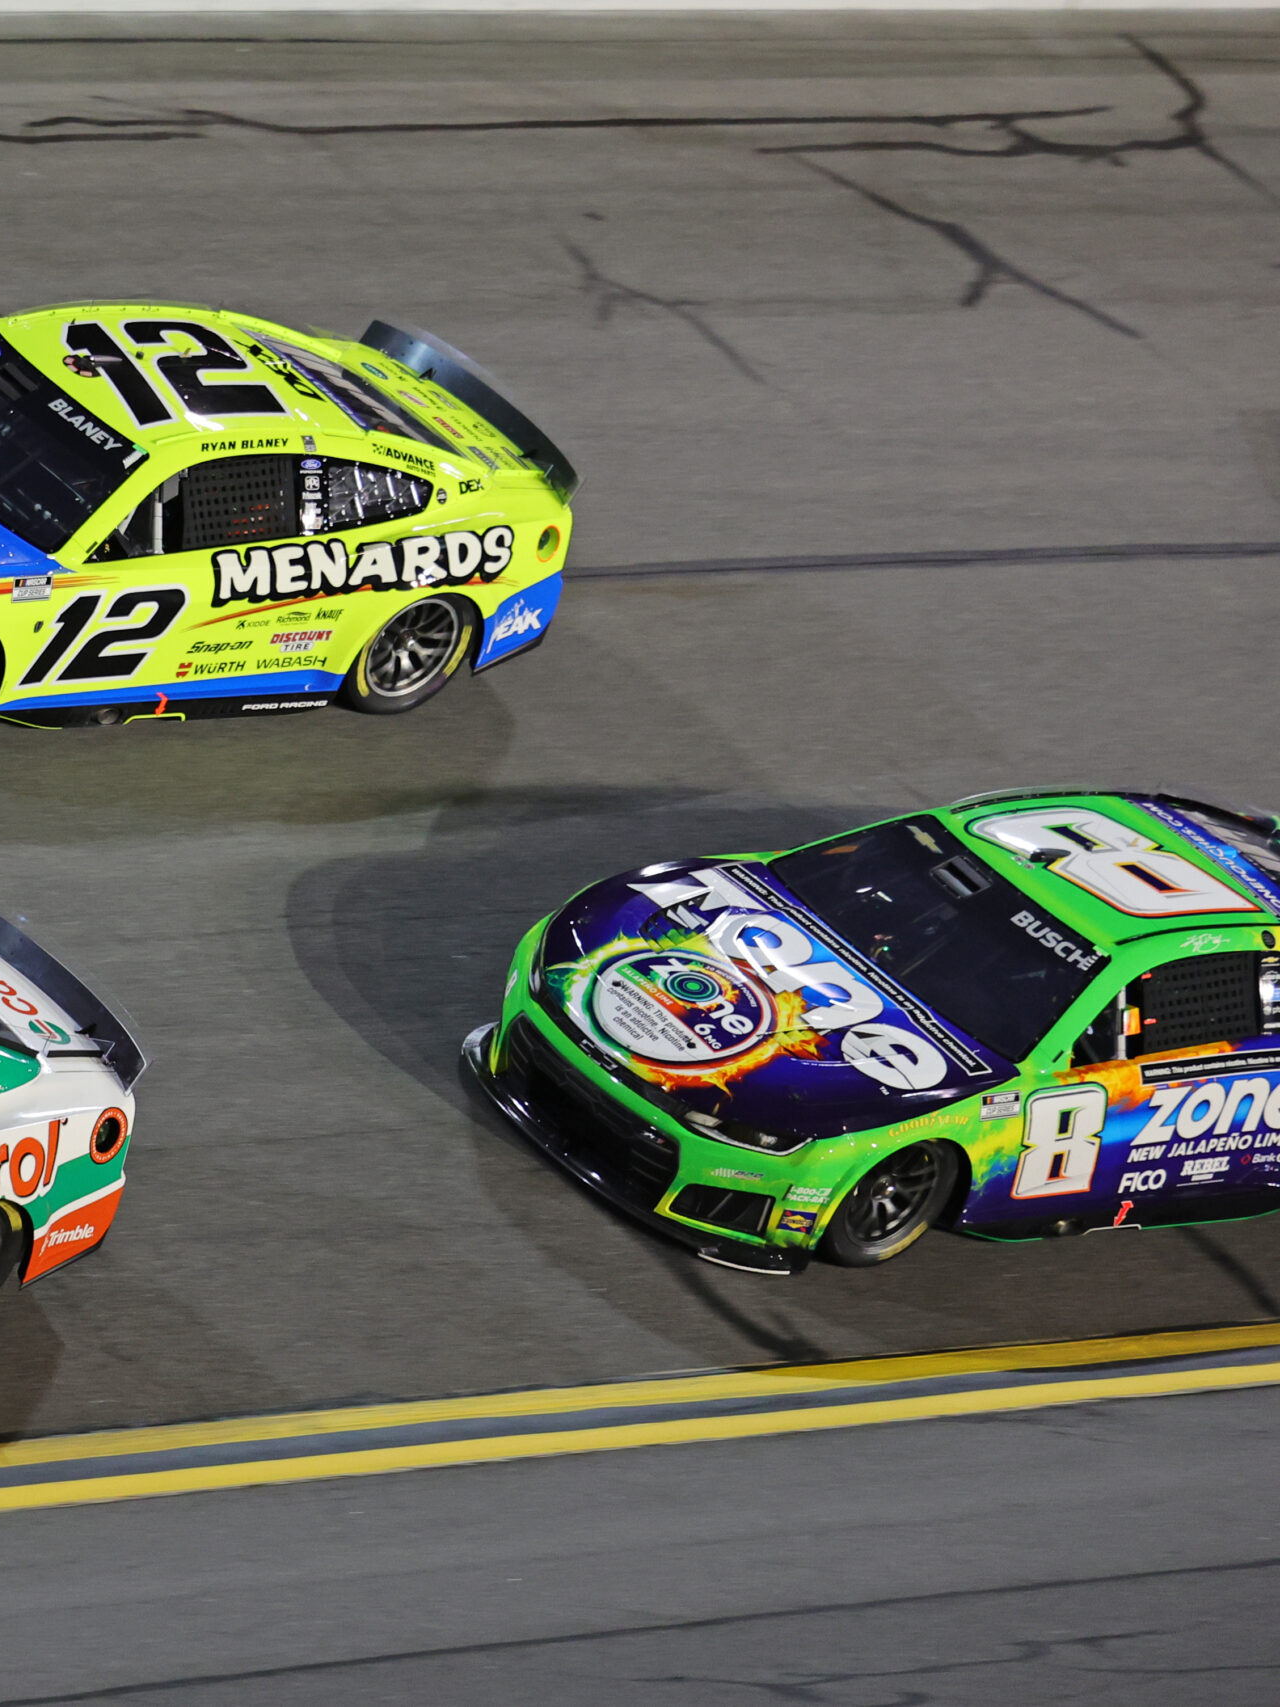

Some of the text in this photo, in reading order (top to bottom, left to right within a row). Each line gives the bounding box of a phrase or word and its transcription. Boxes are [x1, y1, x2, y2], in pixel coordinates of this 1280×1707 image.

[64, 319, 292, 430] 12
[48, 399, 122, 451] BLANEY
[201, 438, 289, 451] RYAN BLANEY
[386, 447, 435, 471] ADVANCE
[459, 478, 485, 495] DEX
[212, 525, 514, 606] MENARDS
[315, 608, 344, 622] KNAUF
[13, 583, 191, 690] 12
[270, 630, 333, 644] DISCOUNT
[486, 607, 543, 654] PEAK
[186, 640, 253, 654] Snap-on
[284, 643, 310, 652] TIRE
[256, 656, 327, 670] WABASH
[242, 700, 328, 711] FORD RACING
[966, 806, 1265, 917] 8
[1010, 910, 1091, 971] BUSCH
[655, 988, 674, 1006] LIME
[607, 987, 634, 1011] contains
[658, 1025, 685, 1052] Nicotine
[614, 1005, 659, 1042] is an addictive
[653, 1008, 667, 1024] This
[1010, 1082, 1108, 1199] 8
[1127, 1145, 1166, 1163] NEW
[1167, 1132, 1253, 1158] JALAPEÑO
[1180, 1156, 1230, 1176] REBEL
[1118, 1168, 1167, 1194] FICO
[48, 1224, 94, 1248] Trimble
